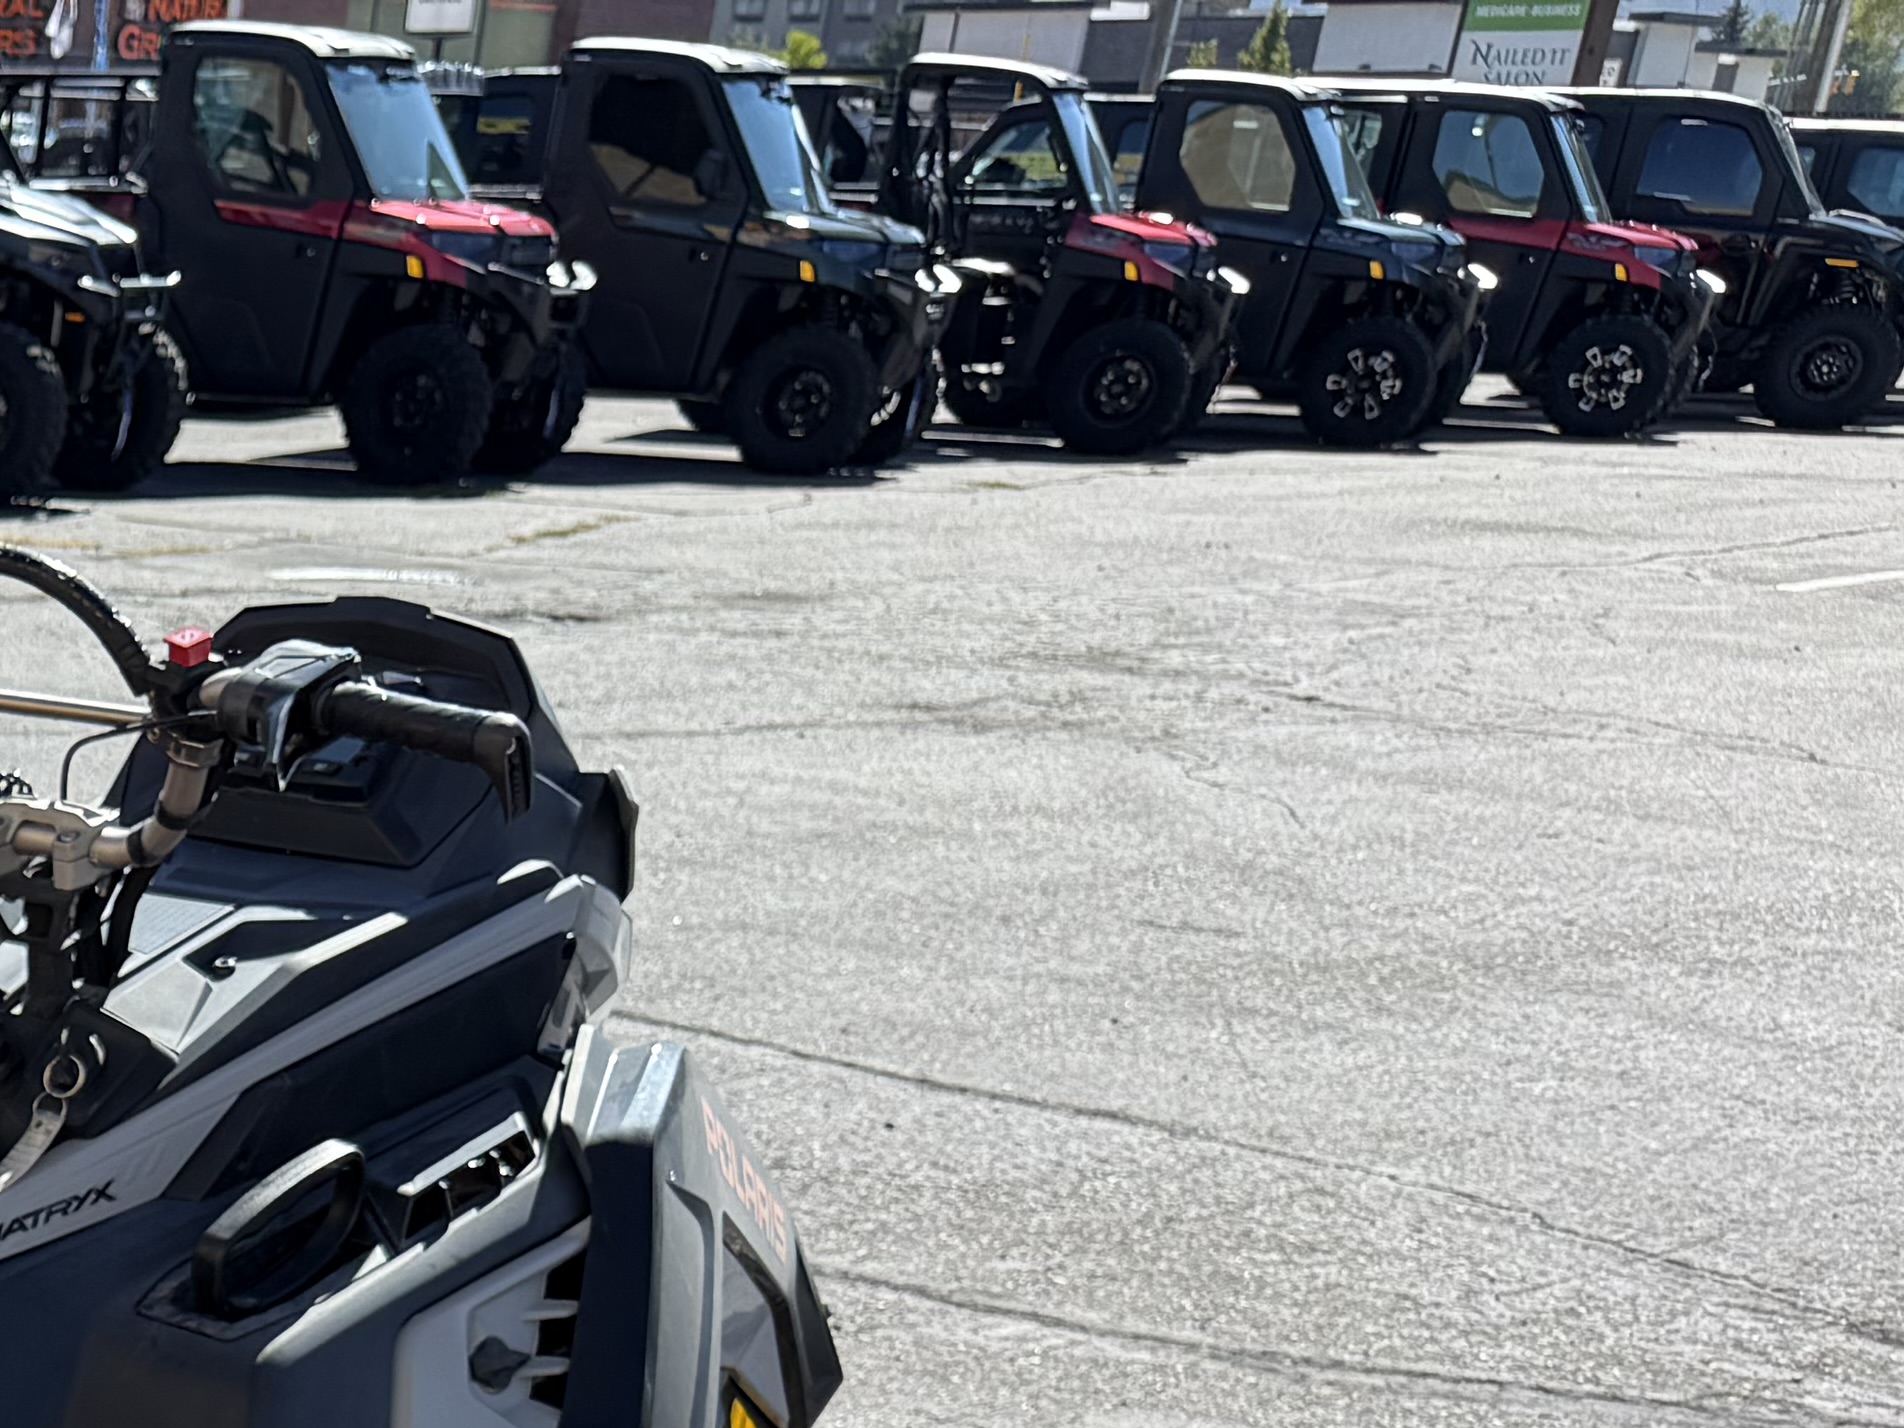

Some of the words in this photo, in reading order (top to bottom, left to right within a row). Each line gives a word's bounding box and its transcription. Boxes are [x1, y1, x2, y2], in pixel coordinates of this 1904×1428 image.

[148, 0, 224, 22] NATUR
[1469, 39, 1546, 68] NAILED
[1550, 48, 1571, 66] IT
[1483, 70, 1546, 86] SALON
[701, 1096, 787, 1264] POLARIS
